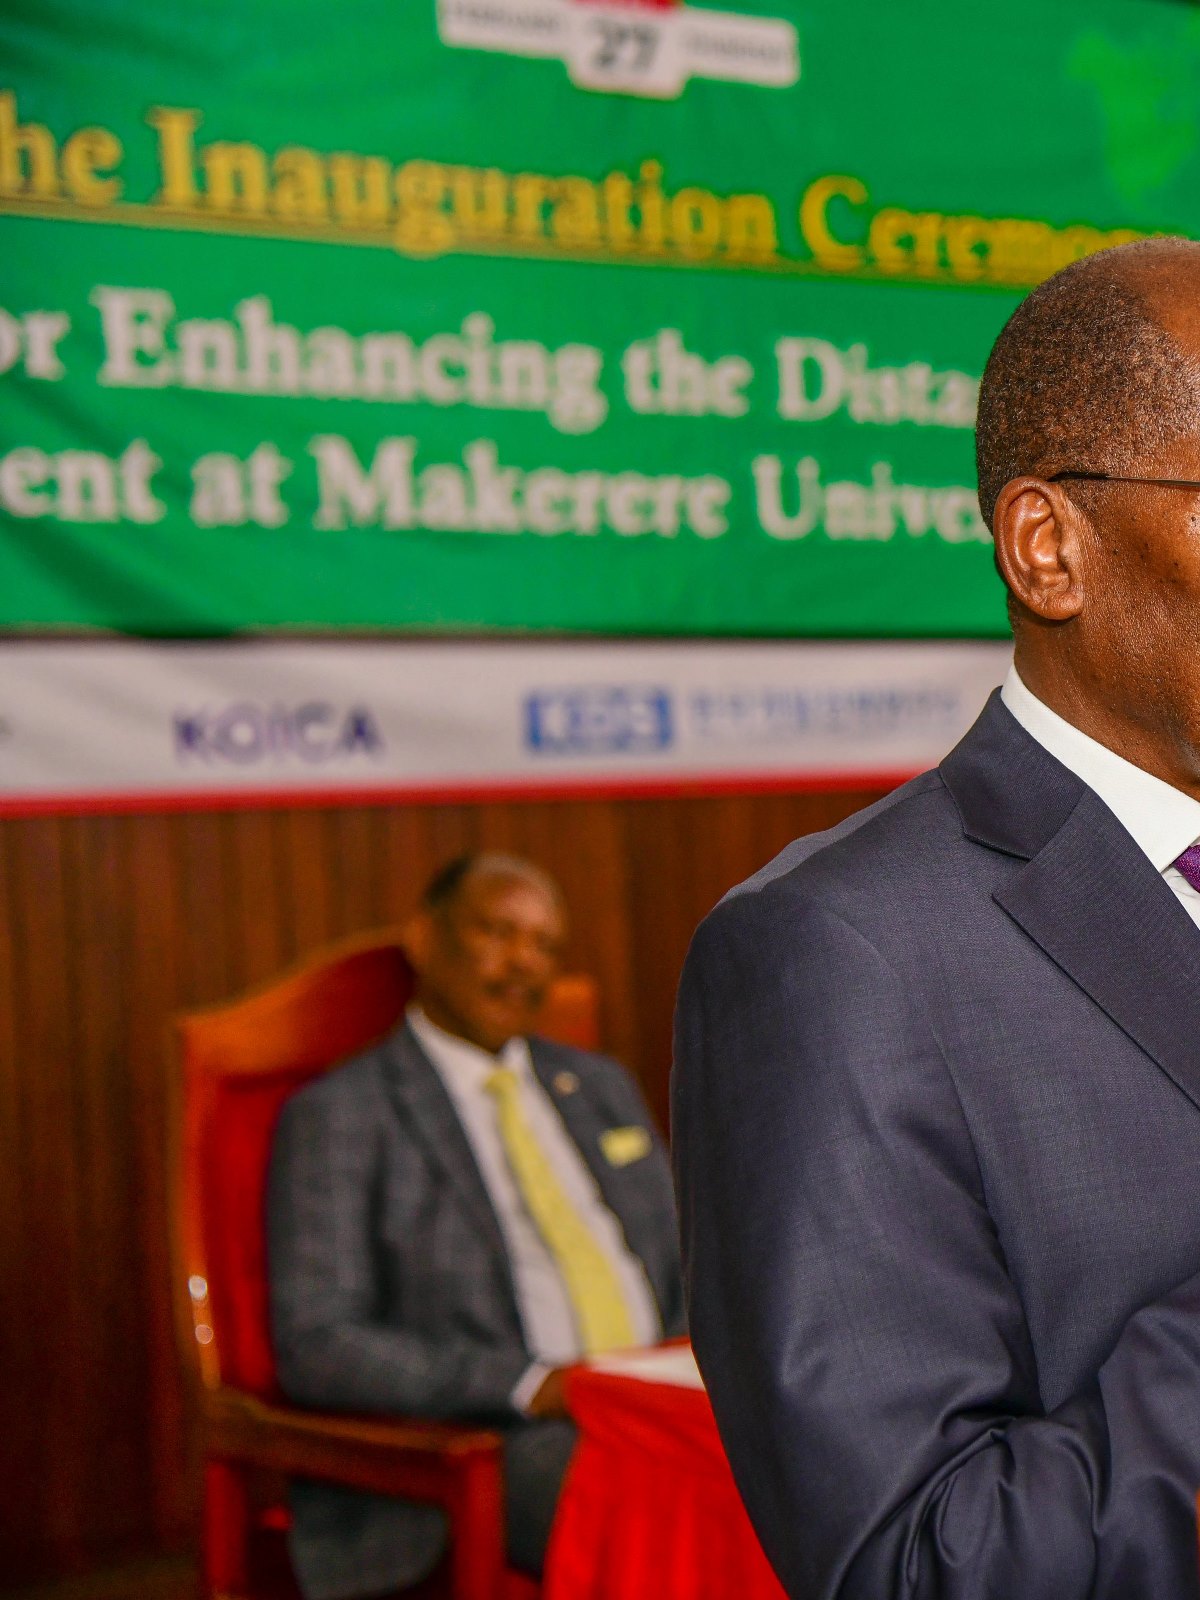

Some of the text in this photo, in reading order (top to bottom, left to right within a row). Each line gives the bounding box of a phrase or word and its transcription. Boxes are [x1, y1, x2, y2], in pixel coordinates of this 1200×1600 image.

[146, 106, 778, 258] Inauguration
[800, 175, 1166, 281] Ceremo
[90, 285, 608, 434] Enhancing
[622, 328, 754, 416] the
[0, 434, 994, 543] ent at Makerere Unive
[172, 698, 388, 765] KOICA
